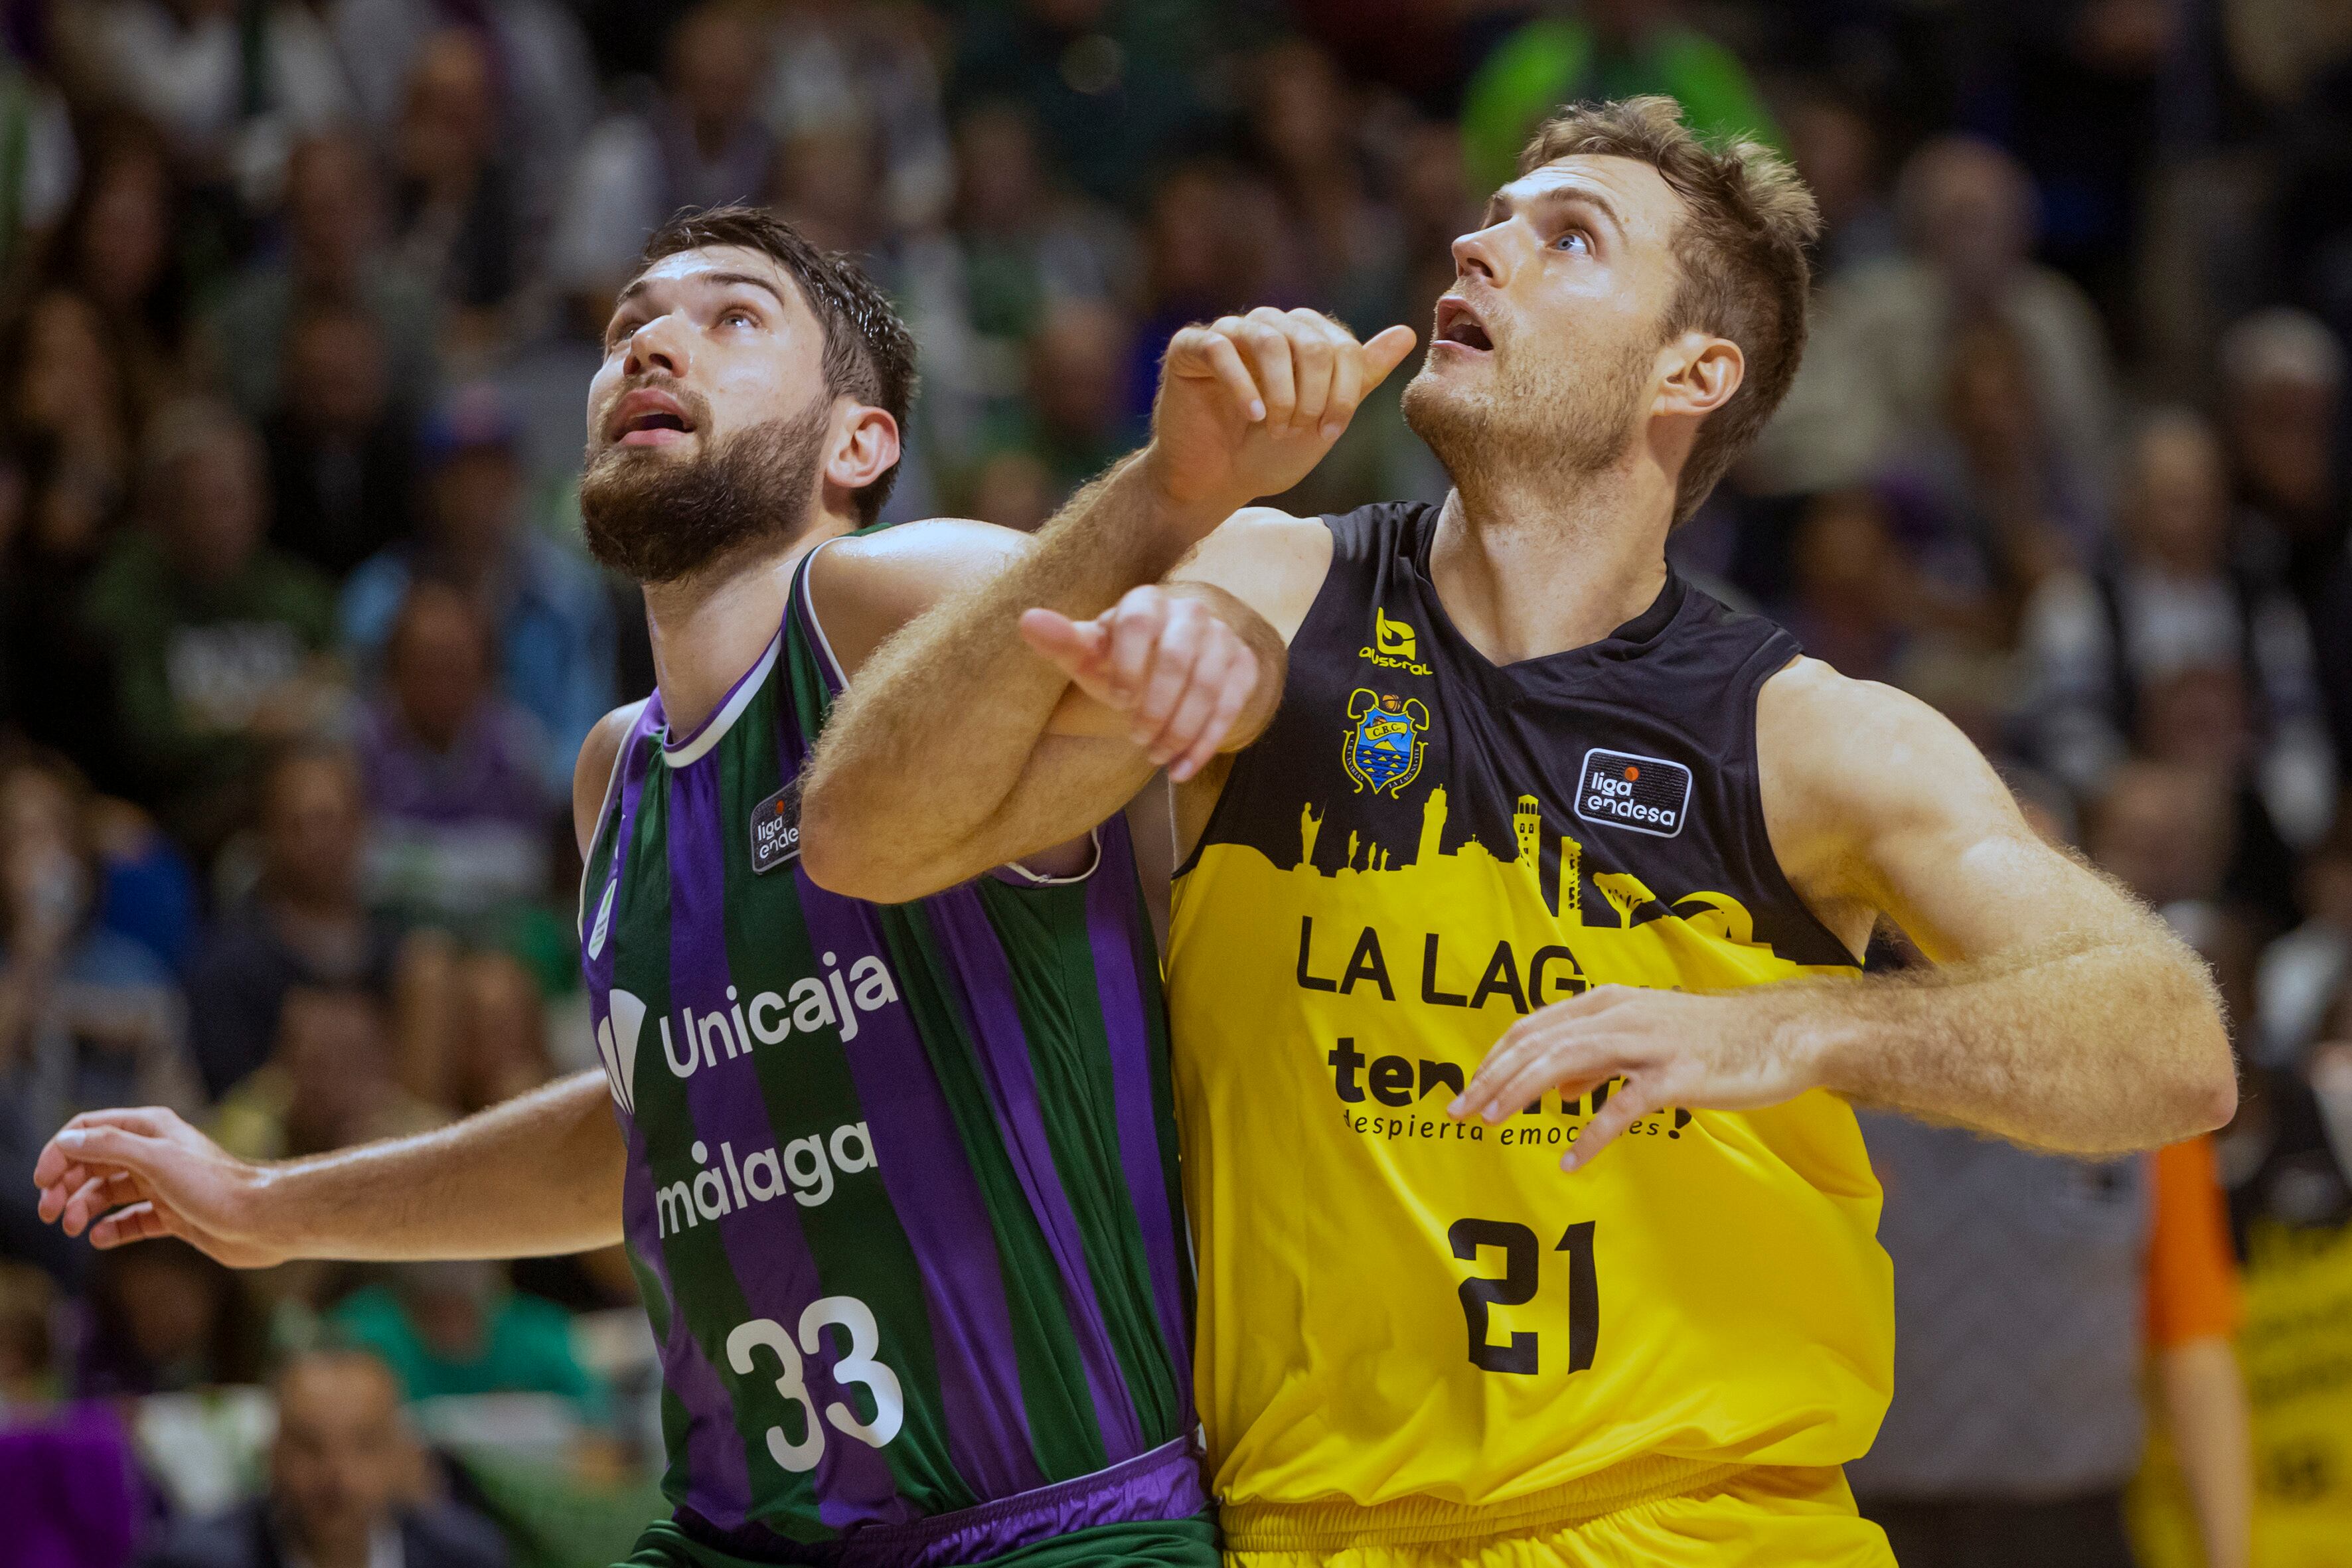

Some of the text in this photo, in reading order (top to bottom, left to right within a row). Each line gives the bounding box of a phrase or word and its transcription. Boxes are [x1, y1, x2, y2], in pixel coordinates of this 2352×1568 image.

[1591, 771, 1632, 797] liga
[1587, 796, 1676, 826] endesa
[757, 816, 783, 841] liga
[759, 827, 799, 859] ende
[1296, 915, 1682, 1015] LA LAG
[659, 951, 899, 1078] Unicaja
[1500, 1120, 1660, 1145] emoces
[1448, 1217, 1600, 1375] 21
[726, 1295, 904, 1473] 33
